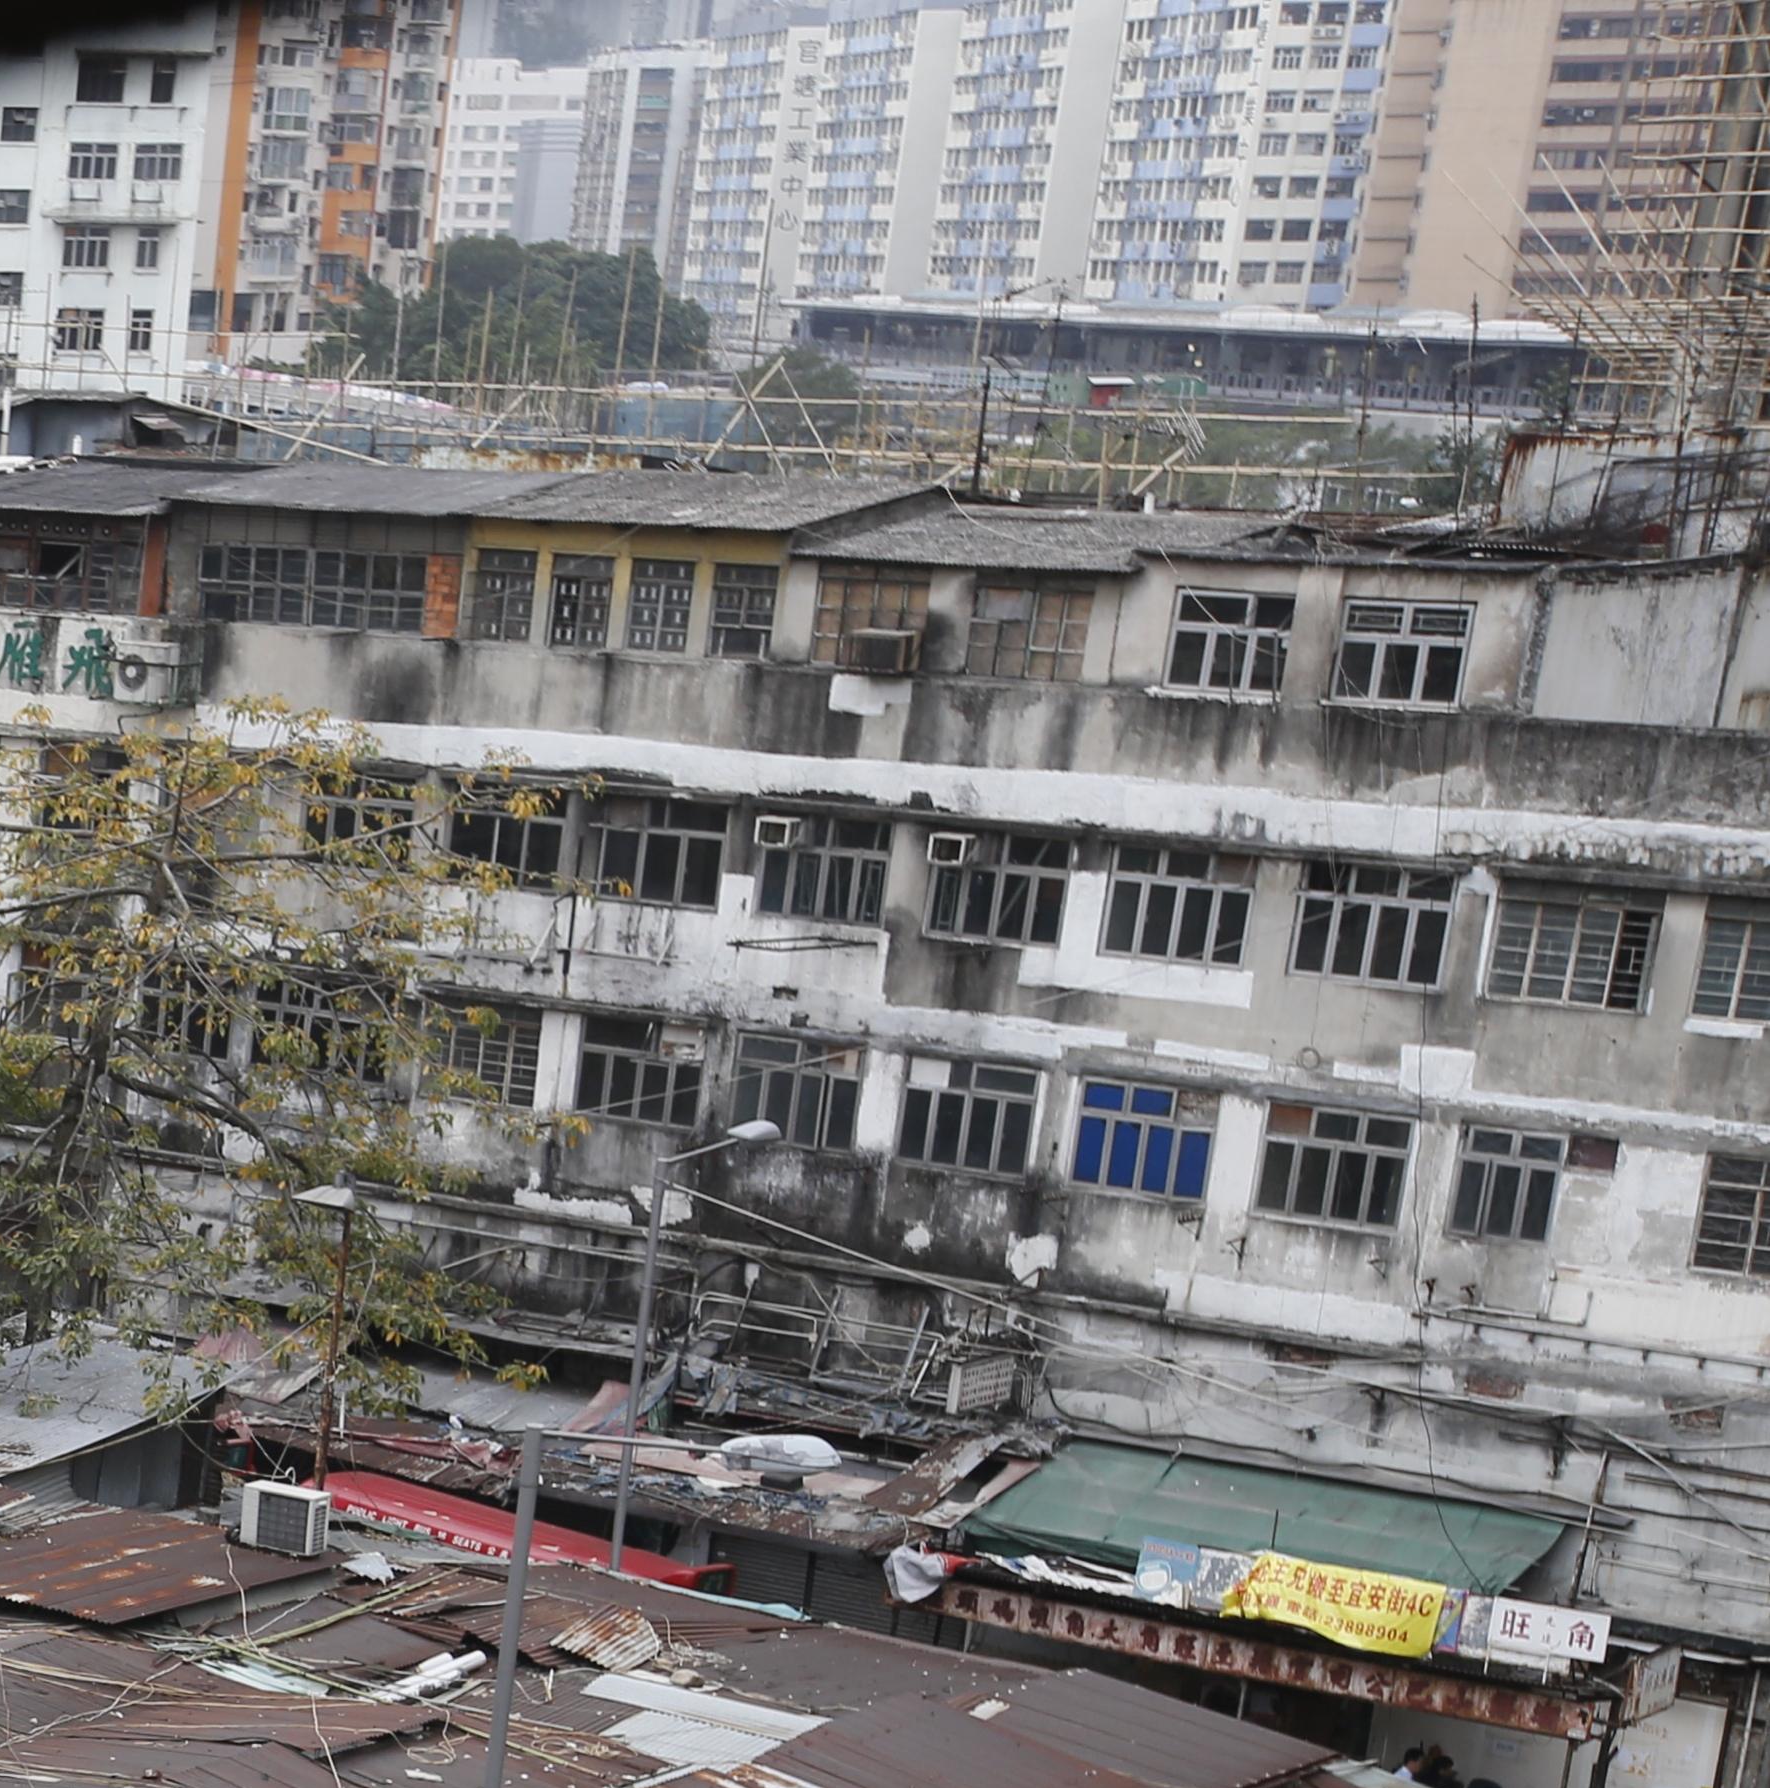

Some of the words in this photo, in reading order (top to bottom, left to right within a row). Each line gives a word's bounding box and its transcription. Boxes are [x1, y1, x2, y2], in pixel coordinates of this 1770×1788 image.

[346, 1504, 377, 1521] PUBLIC
[382, 1516, 408, 1530] LIGHT
[452, 1535, 482, 1552] SEATS
